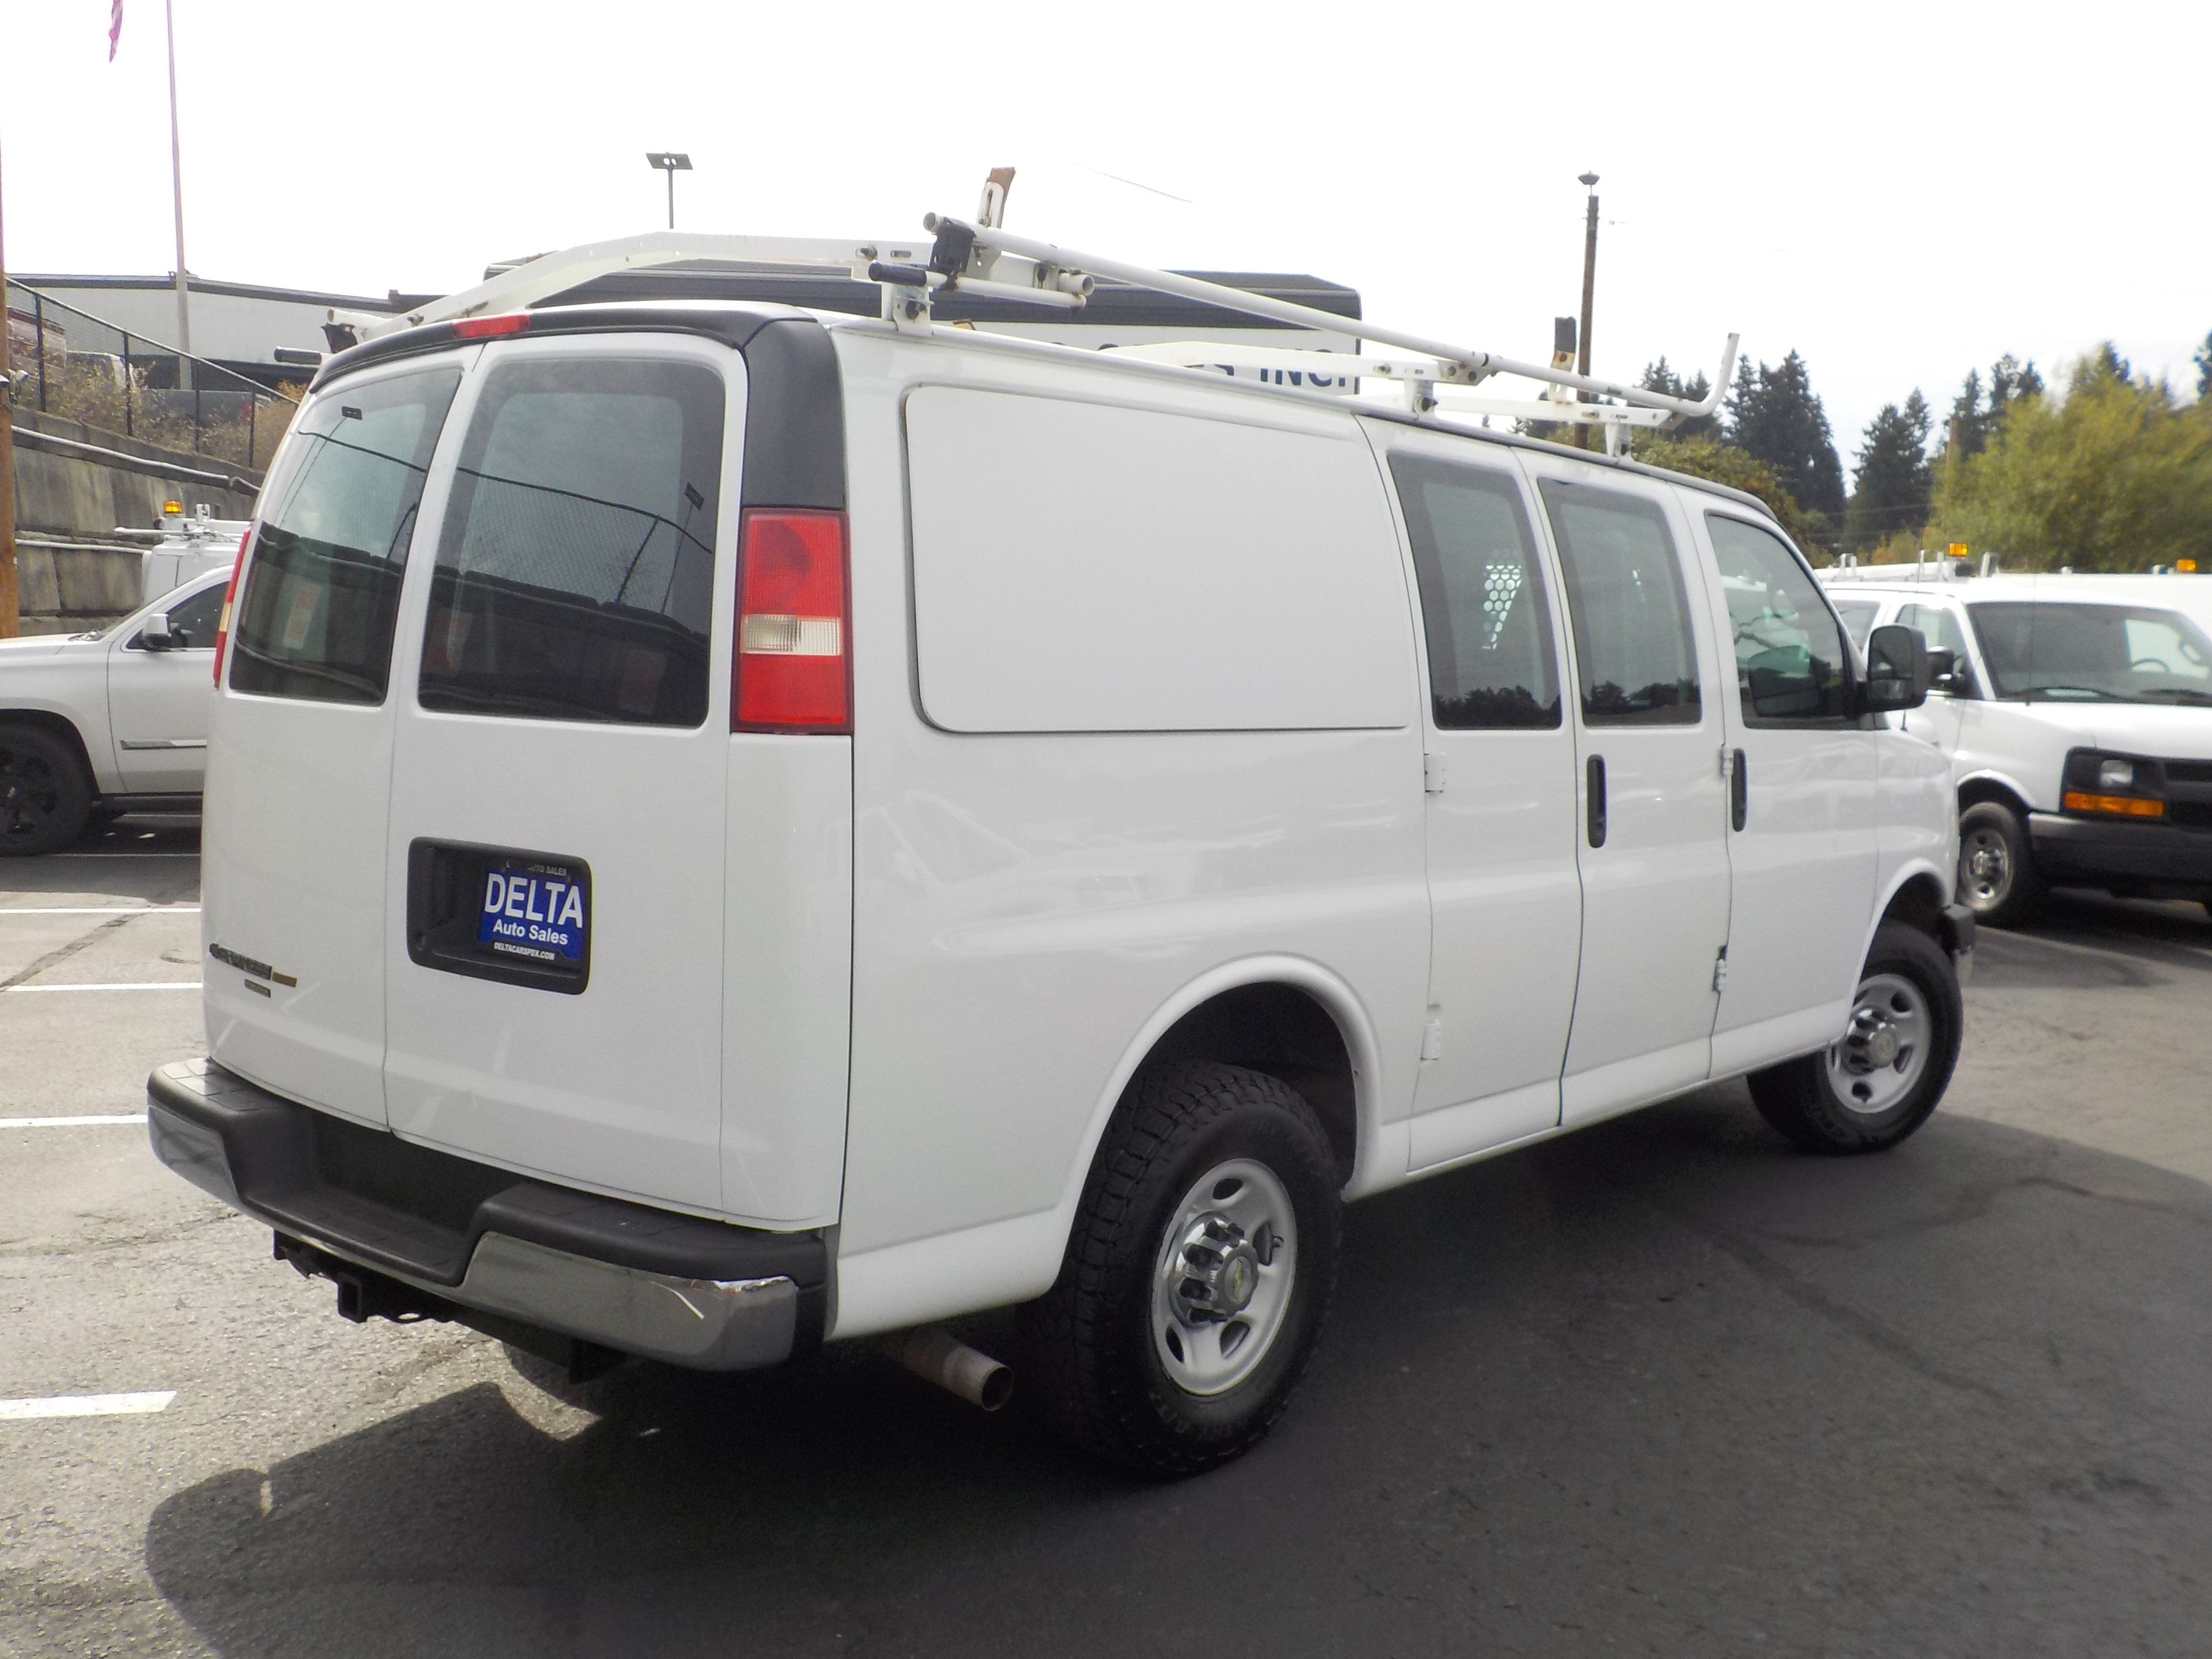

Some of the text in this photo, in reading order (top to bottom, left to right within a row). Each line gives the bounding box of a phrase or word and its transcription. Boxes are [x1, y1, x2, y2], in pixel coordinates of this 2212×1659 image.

[546, 866, 567, 876] SALES
[484, 873, 583, 928] DELTA
[493, 919, 568, 945] Auto Sales
[493, 942, 555, 961] DELTACARSPDX.COM
